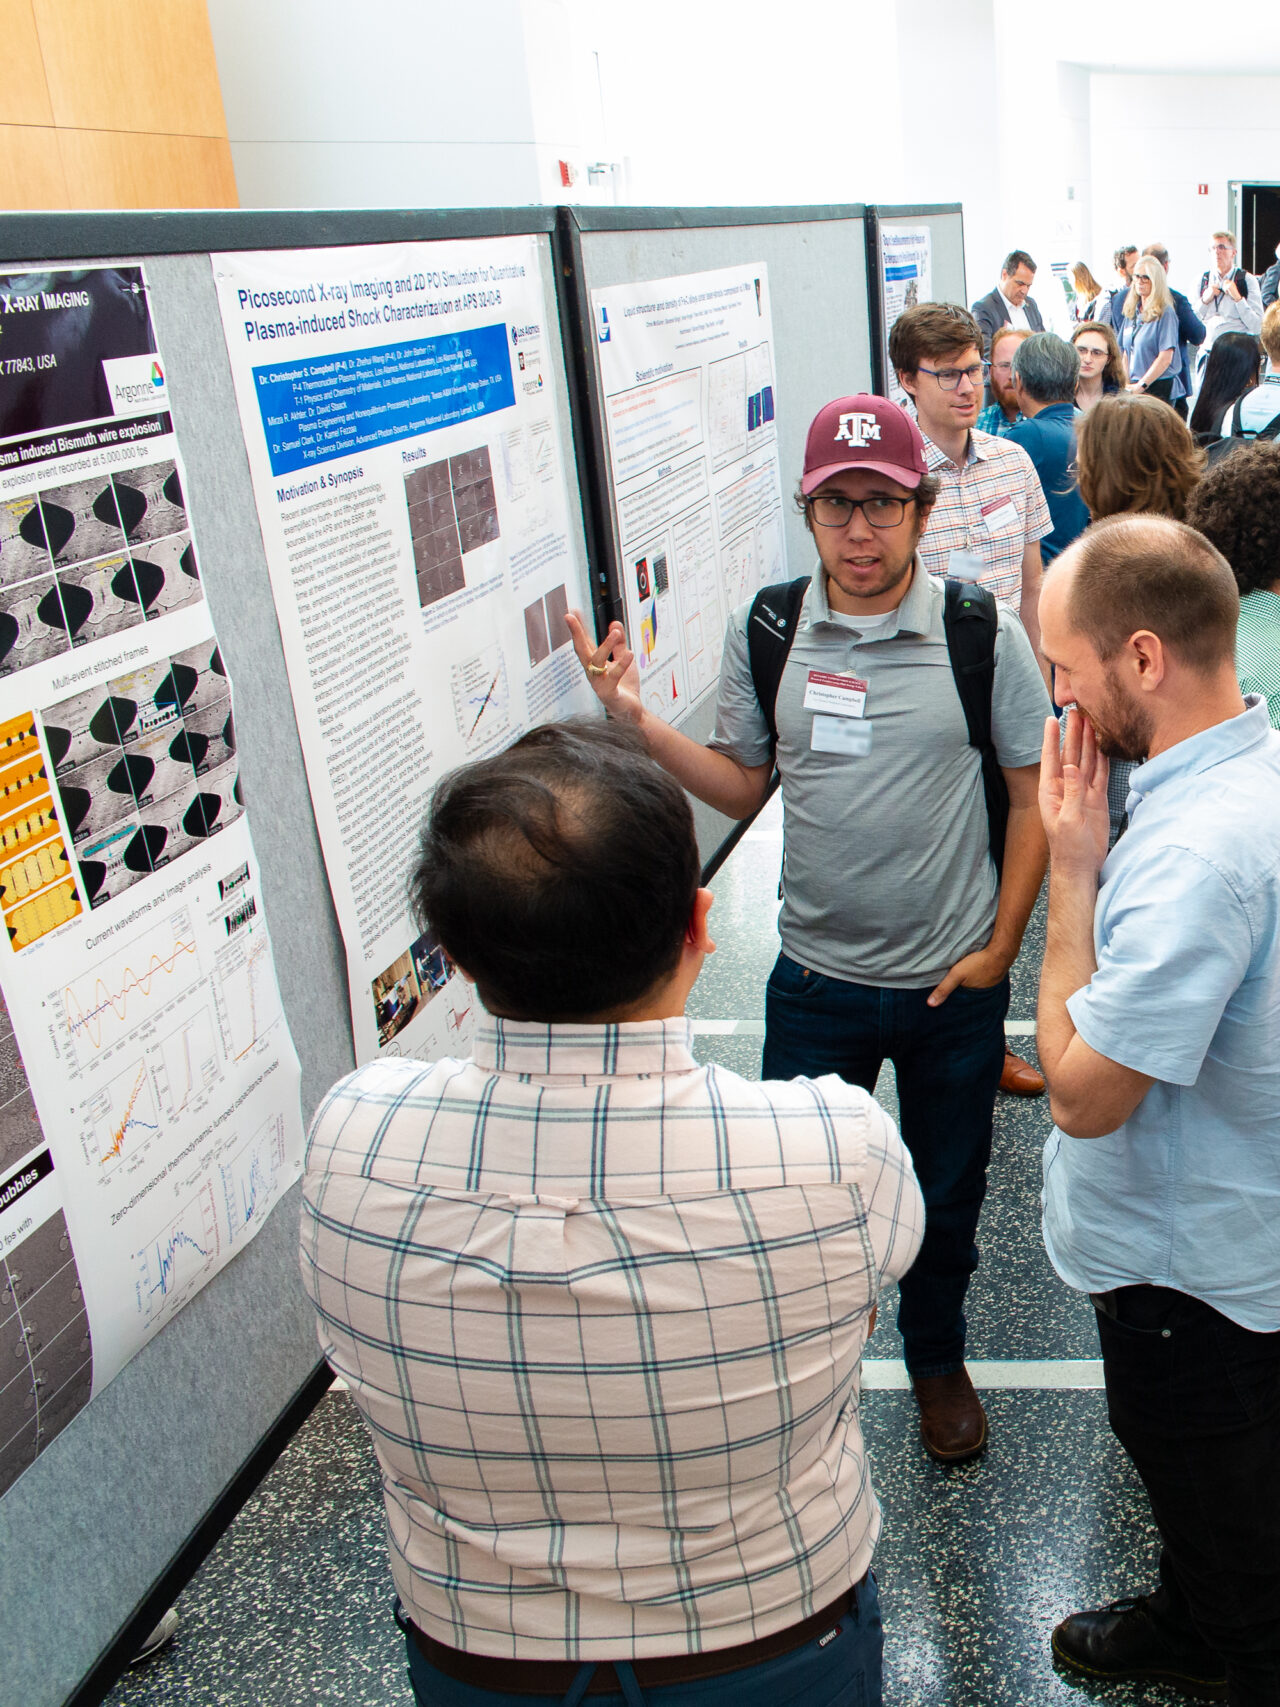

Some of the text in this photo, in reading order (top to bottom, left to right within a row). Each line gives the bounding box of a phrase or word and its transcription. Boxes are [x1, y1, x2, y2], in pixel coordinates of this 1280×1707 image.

[3, 293, 45, 314] X-RAY
[238, 264, 526, 310] Picosecond X-ray Imaging and 2D PCI Simulation for Quantitative
[245, 310, 346, 342] Plasma-induced
[348, 307, 381, 328] Shock
[383, 297, 454, 323] Characterization
[454, 298, 462, 311] at
[463, 293, 478, 310] APS
[5, 353, 57, 374] 77843, USA
[270, 369, 303, 383] Christopher
[310, 363, 334, 376] Campbell
[115, 382, 154, 403] Argonne
[0, 419, 162, 466] sma induced Bismuth wire explosion
[402, 447, 427, 463] Results
[2, 443, 149, 489] explosion event recorded at 5,000,000 fps
[276, 466, 364, 503] Motivation & Synopsis
[52, 644, 150, 691] Multi-event stitched frames
[85, 926, 114, 950] Current
[114, 901, 152, 932] waveforms
[152, 892, 166, 907] and
[187, 863, 212, 882] analysis
[110, 1167, 168, 1226] Zero-dimensional
[167, 1125, 213, 1172] thermodynamic
[213, 1104, 235, 1129] lumped
[4, 1217, 33, 1245] fps with
